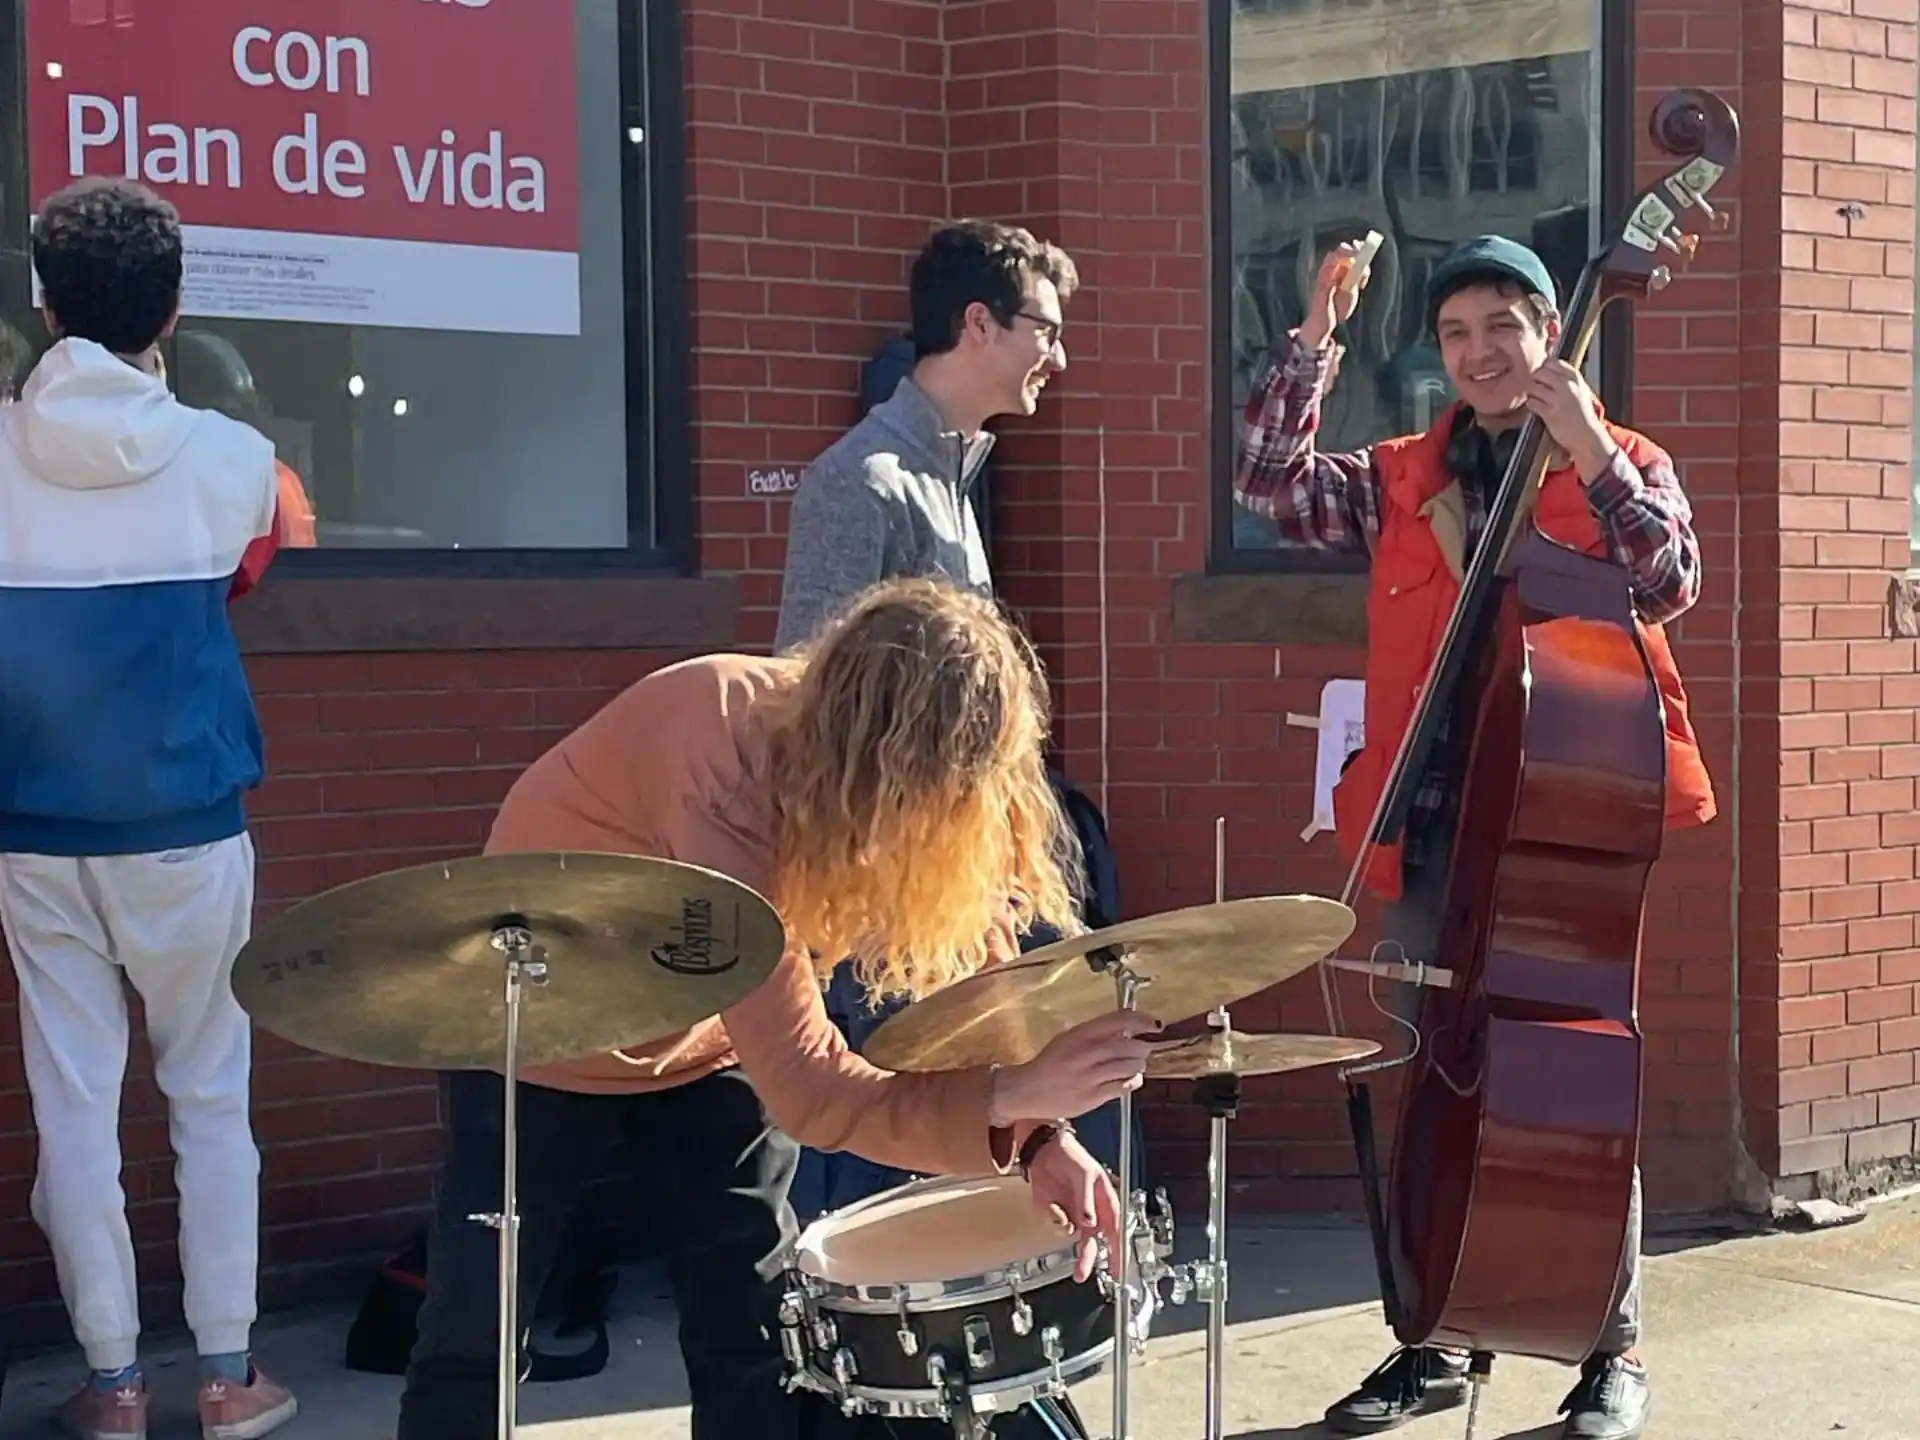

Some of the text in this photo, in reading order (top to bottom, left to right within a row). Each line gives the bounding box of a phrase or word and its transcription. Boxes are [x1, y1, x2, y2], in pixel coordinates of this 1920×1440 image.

[232, 26, 370, 96] con
[68, 94, 546, 213] Plan de vida
